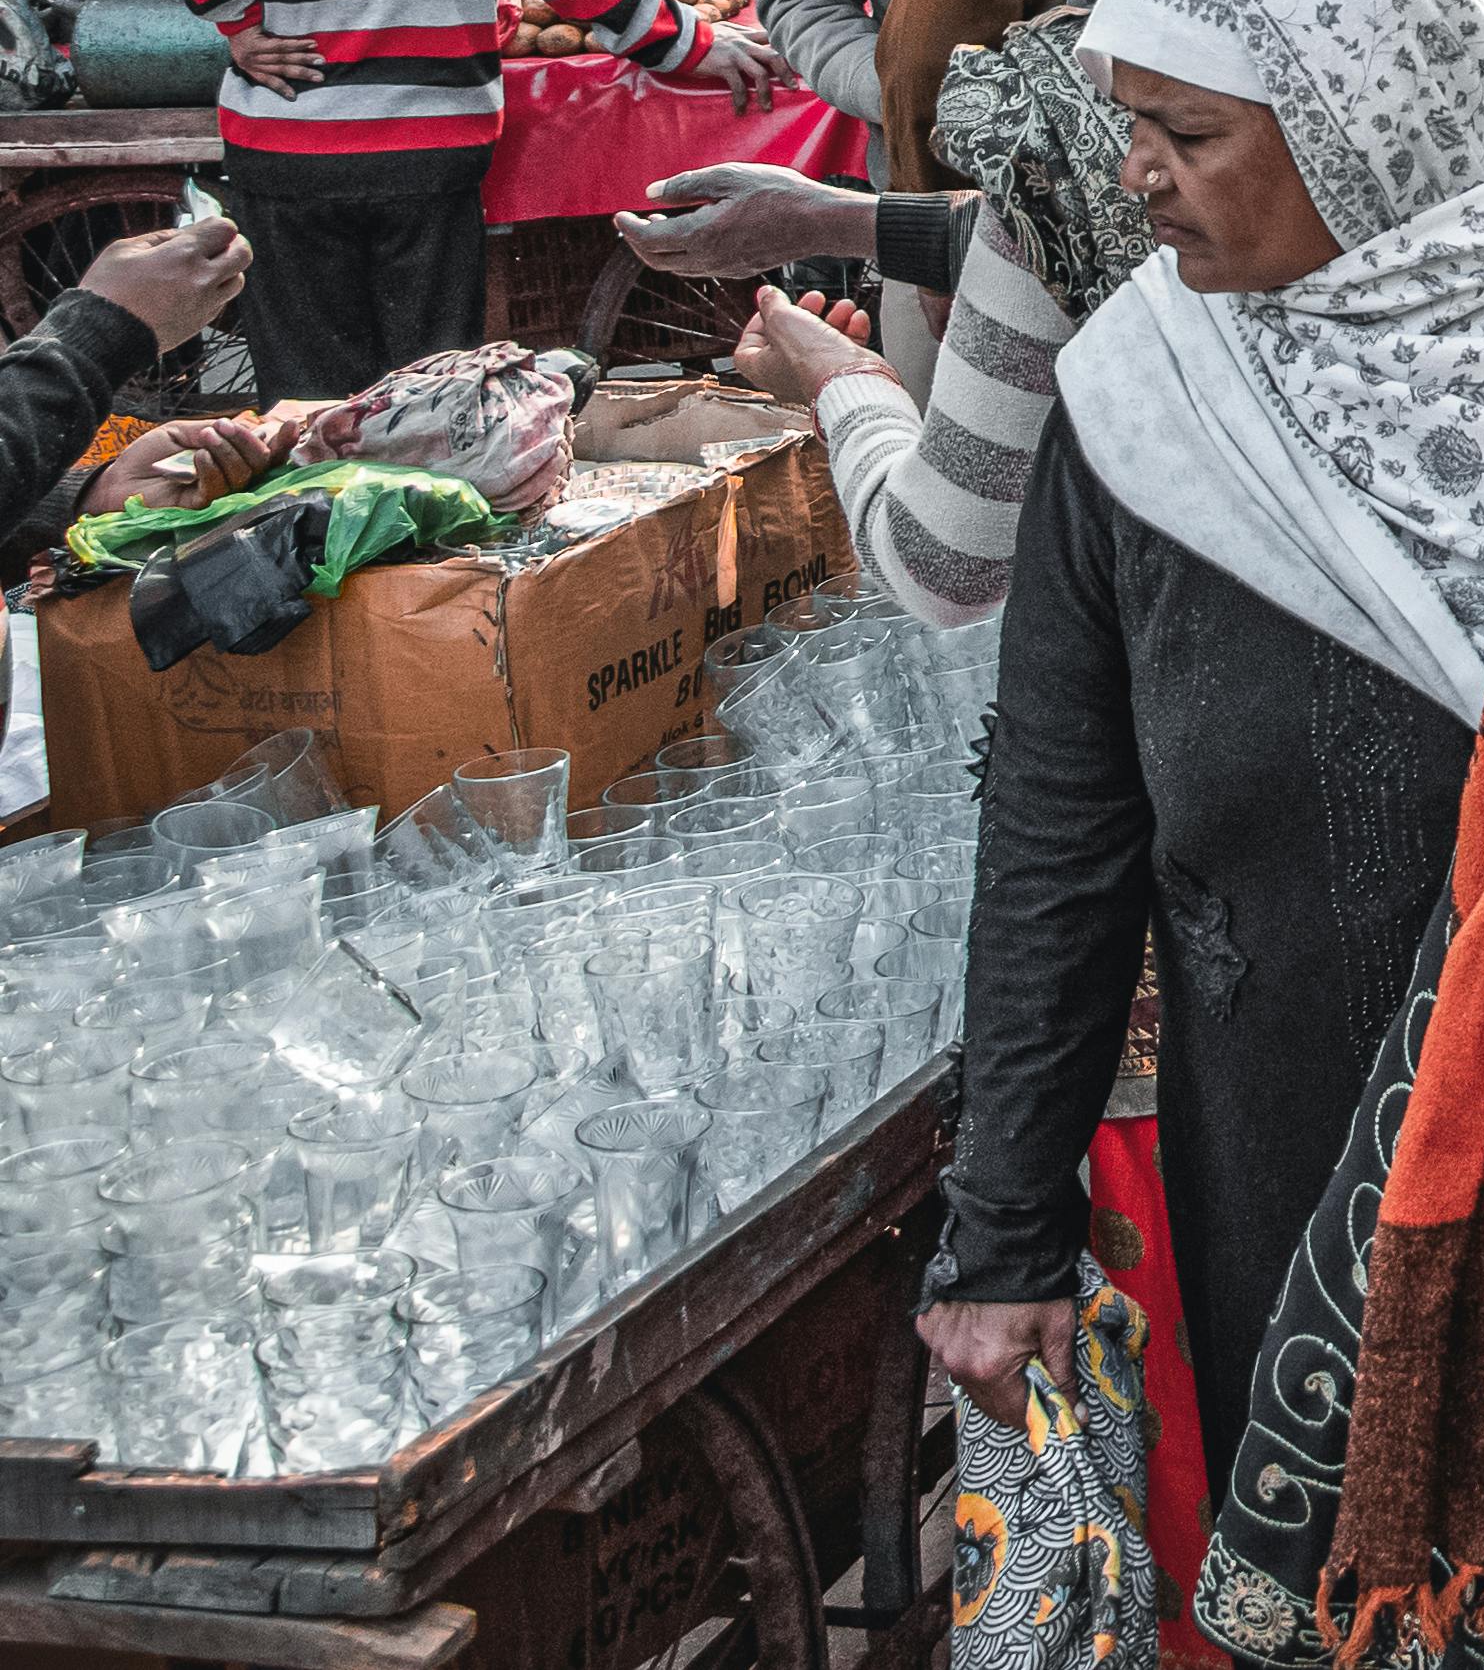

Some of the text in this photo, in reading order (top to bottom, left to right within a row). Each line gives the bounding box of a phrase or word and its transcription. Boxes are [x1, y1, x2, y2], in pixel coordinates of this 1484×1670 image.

[587, 629, 683, 712] SPARKLE
[705, 596, 742, 644] BIG
[764, 553, 836, 617] BOWL
